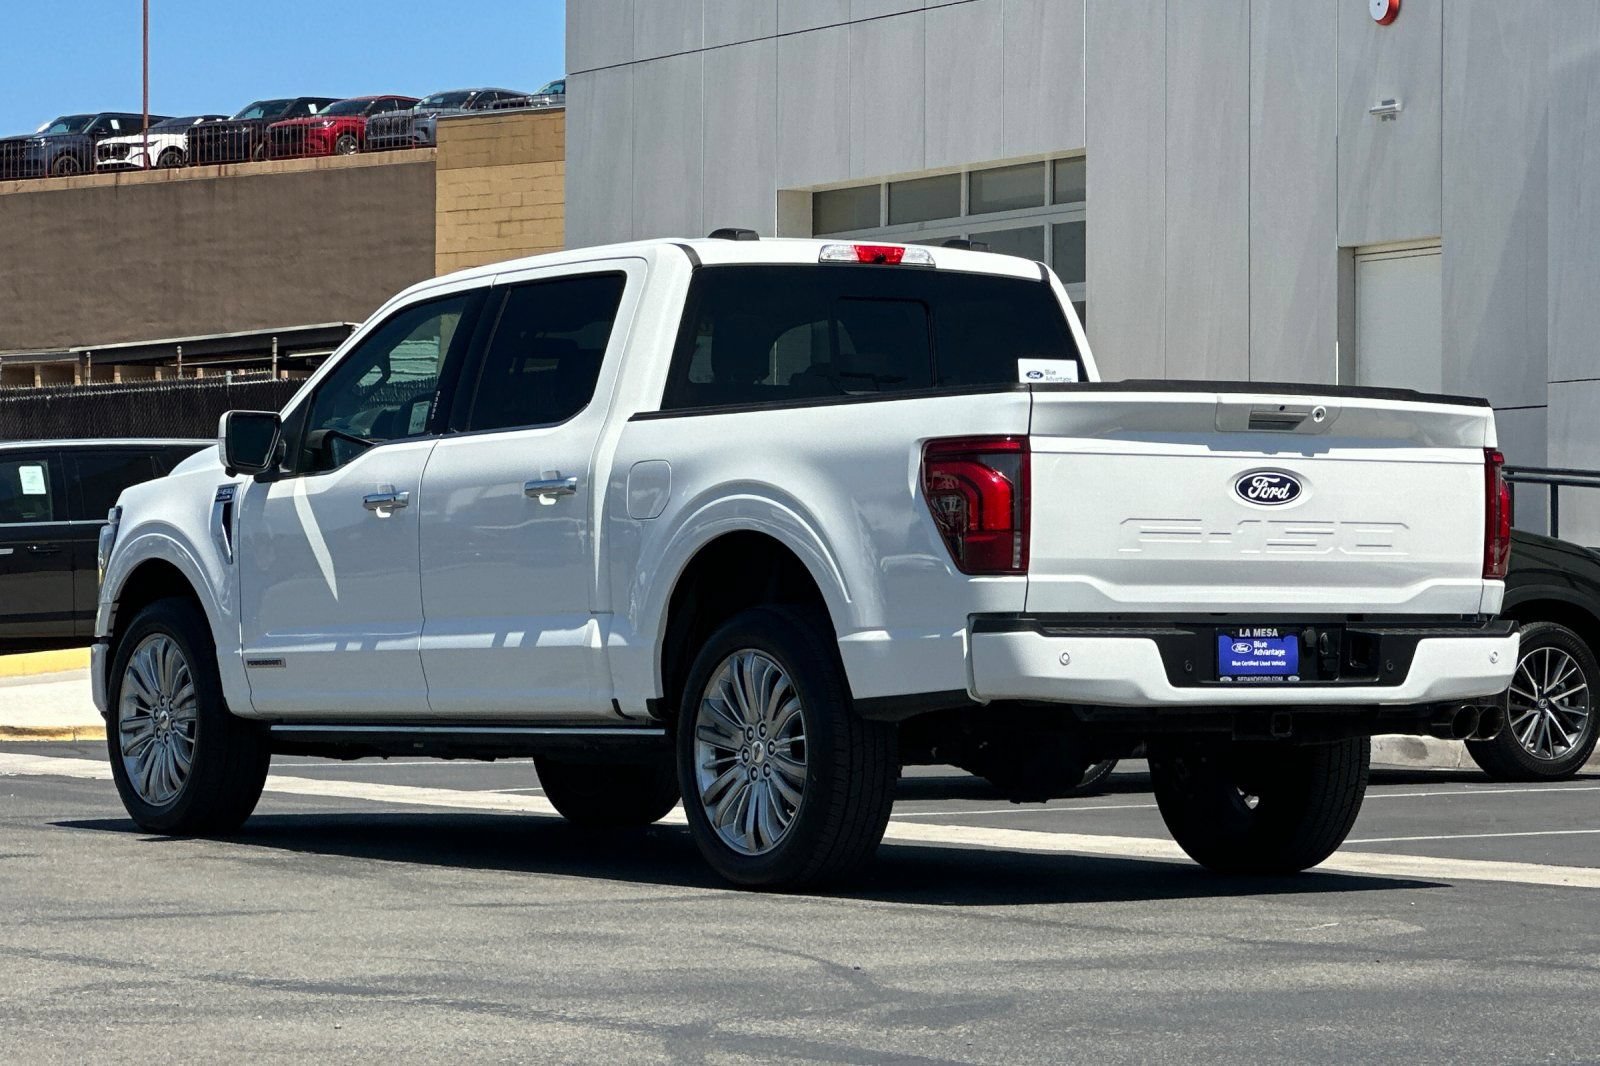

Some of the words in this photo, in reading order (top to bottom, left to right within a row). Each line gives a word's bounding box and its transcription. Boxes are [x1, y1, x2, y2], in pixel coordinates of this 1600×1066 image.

[1247, 476, 1291, 499] Ford
[1118, 518, 1410, 556] F-150
[1239, 628, 1251, 637] LA
[1253, 628, 1278, 637] MESA
[1253, 640, 1268, 648] Blue
[1253, 649, 1286, 657] Advantage
